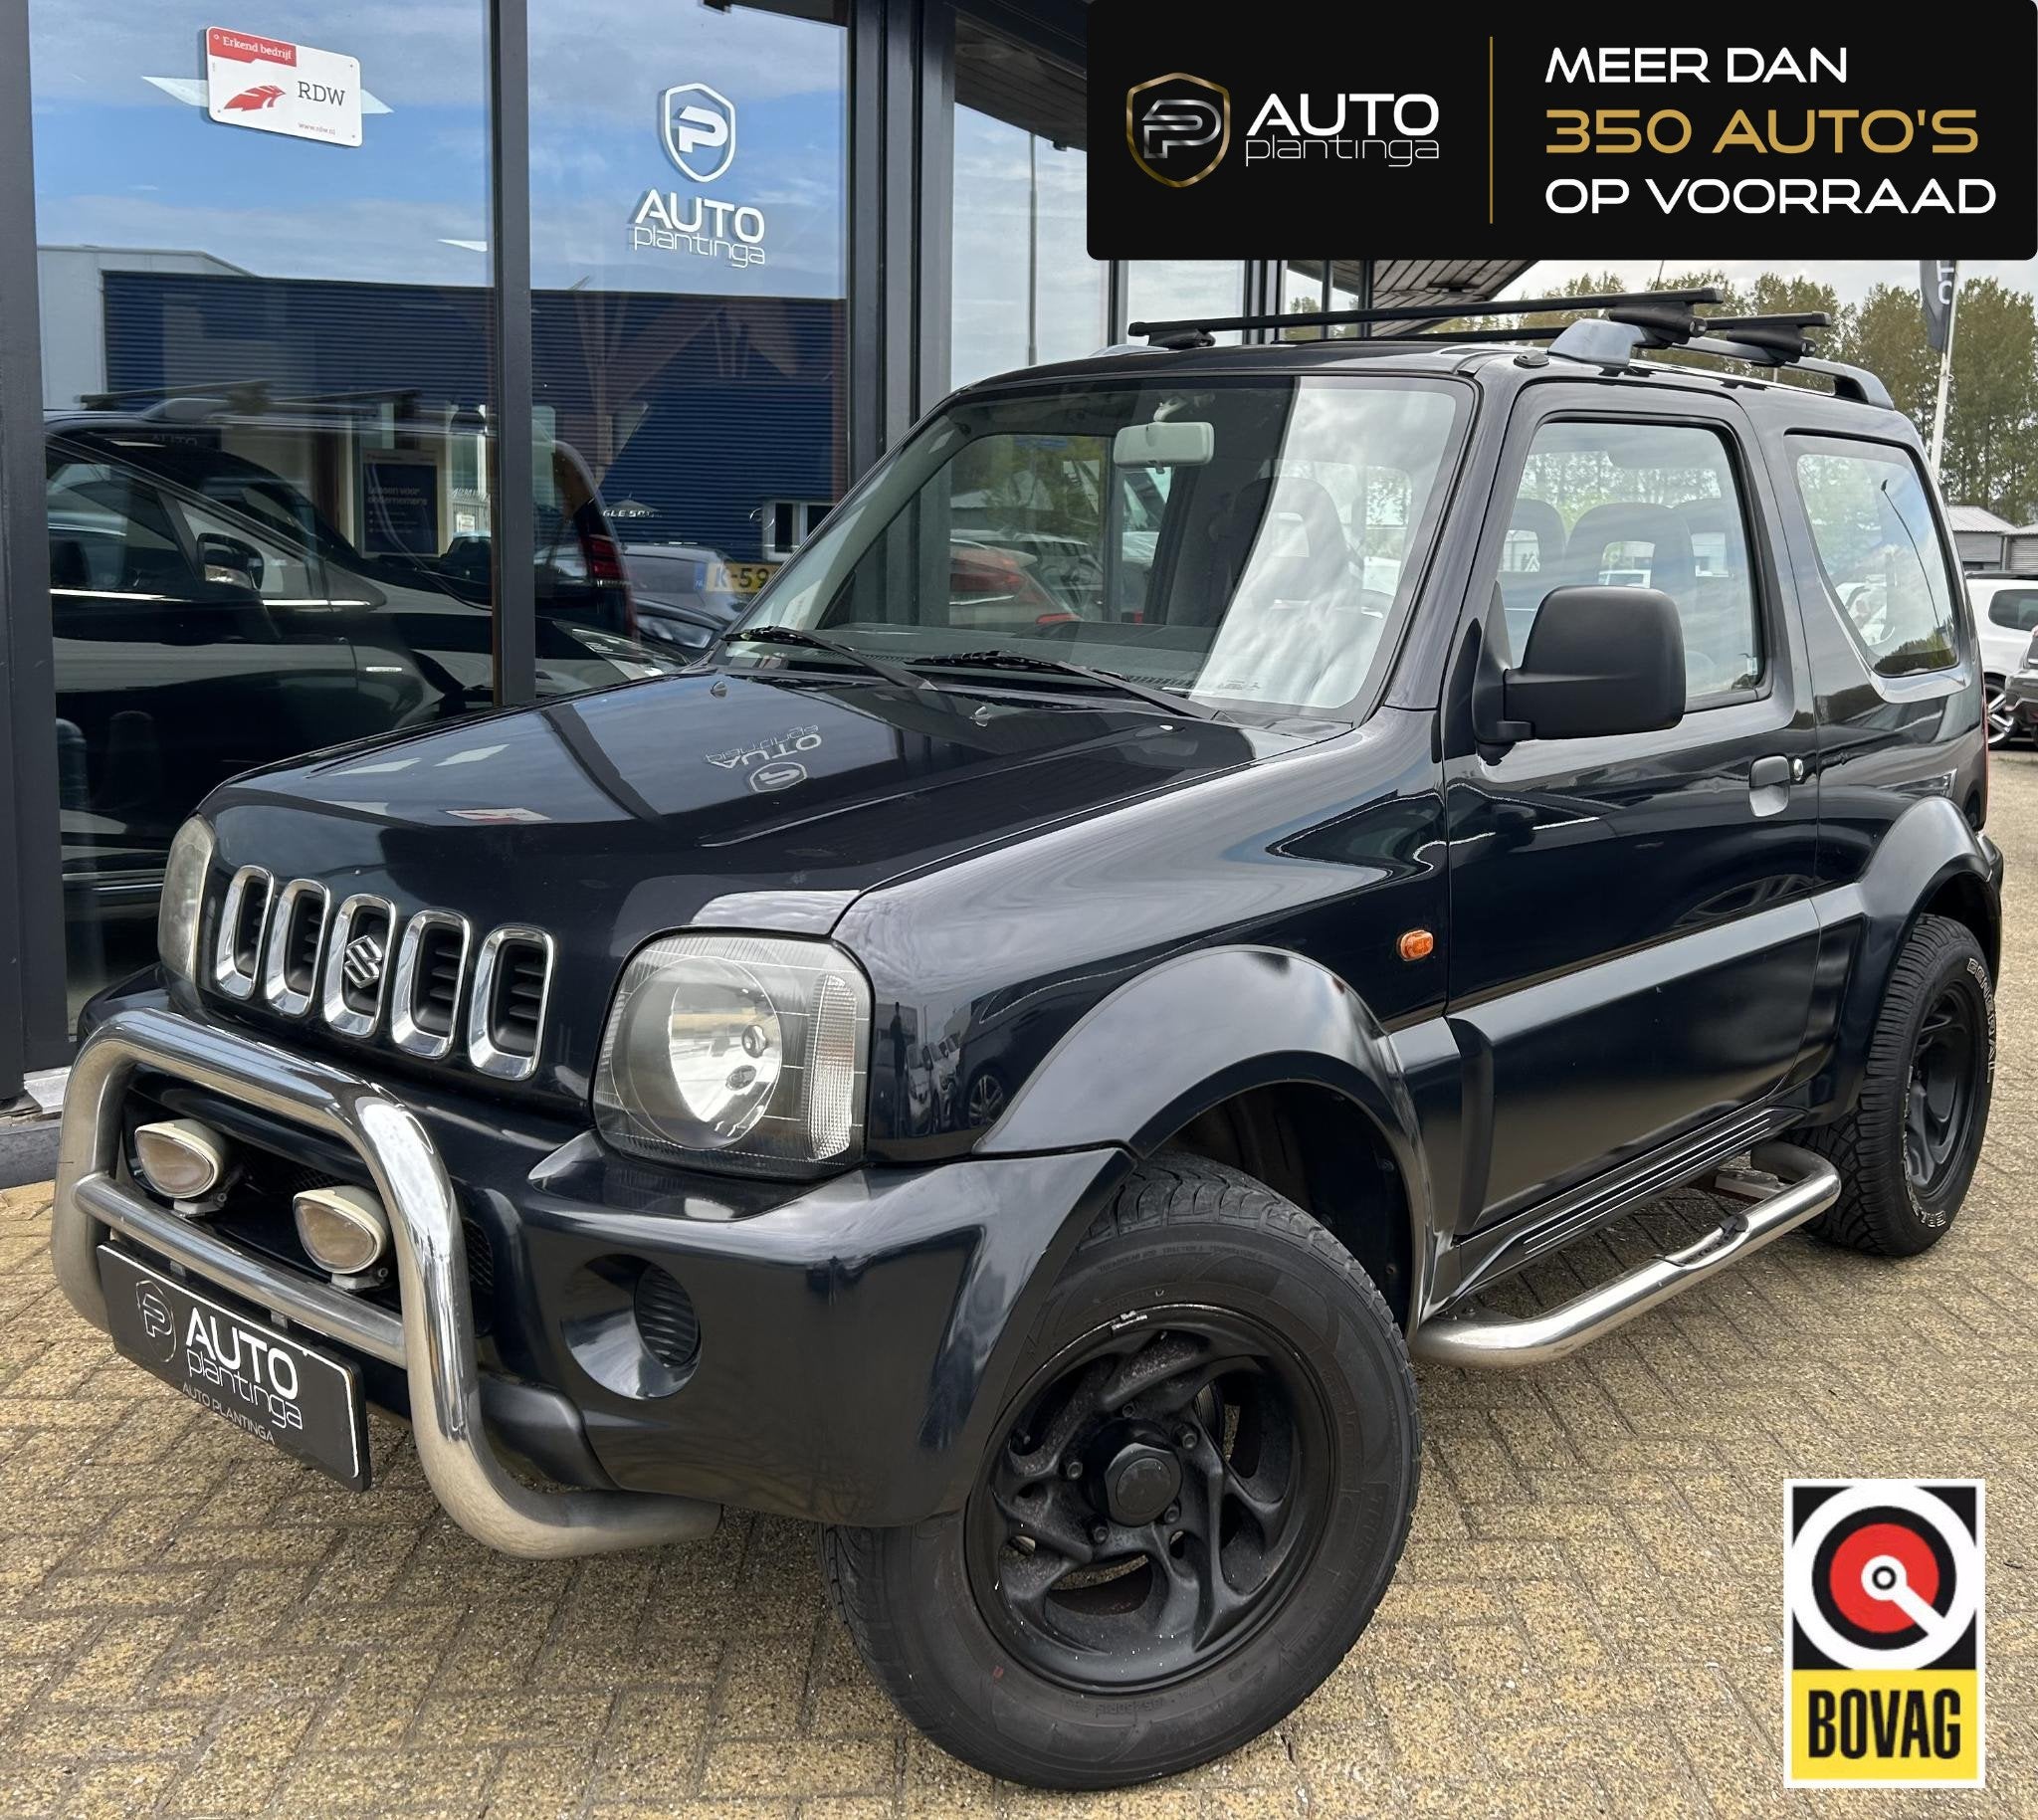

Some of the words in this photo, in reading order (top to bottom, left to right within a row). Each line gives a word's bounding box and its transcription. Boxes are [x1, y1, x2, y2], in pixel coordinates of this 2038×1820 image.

[222, 36, 259, 53] Erkend
[260, 44, 293, 61] bedrijf
[298, 81, 345, 105] RDW
[635, 189, 765, 244] AUTO
[634, 225, 765, 269] plantinga
[186, 1308, 299, 1400] AUTO
[182, 1383, 210, 1407] AUTO
[212, 1399, 275, 1445] PLANTINGA
[186, 1348, 303, 1430] plantinga
